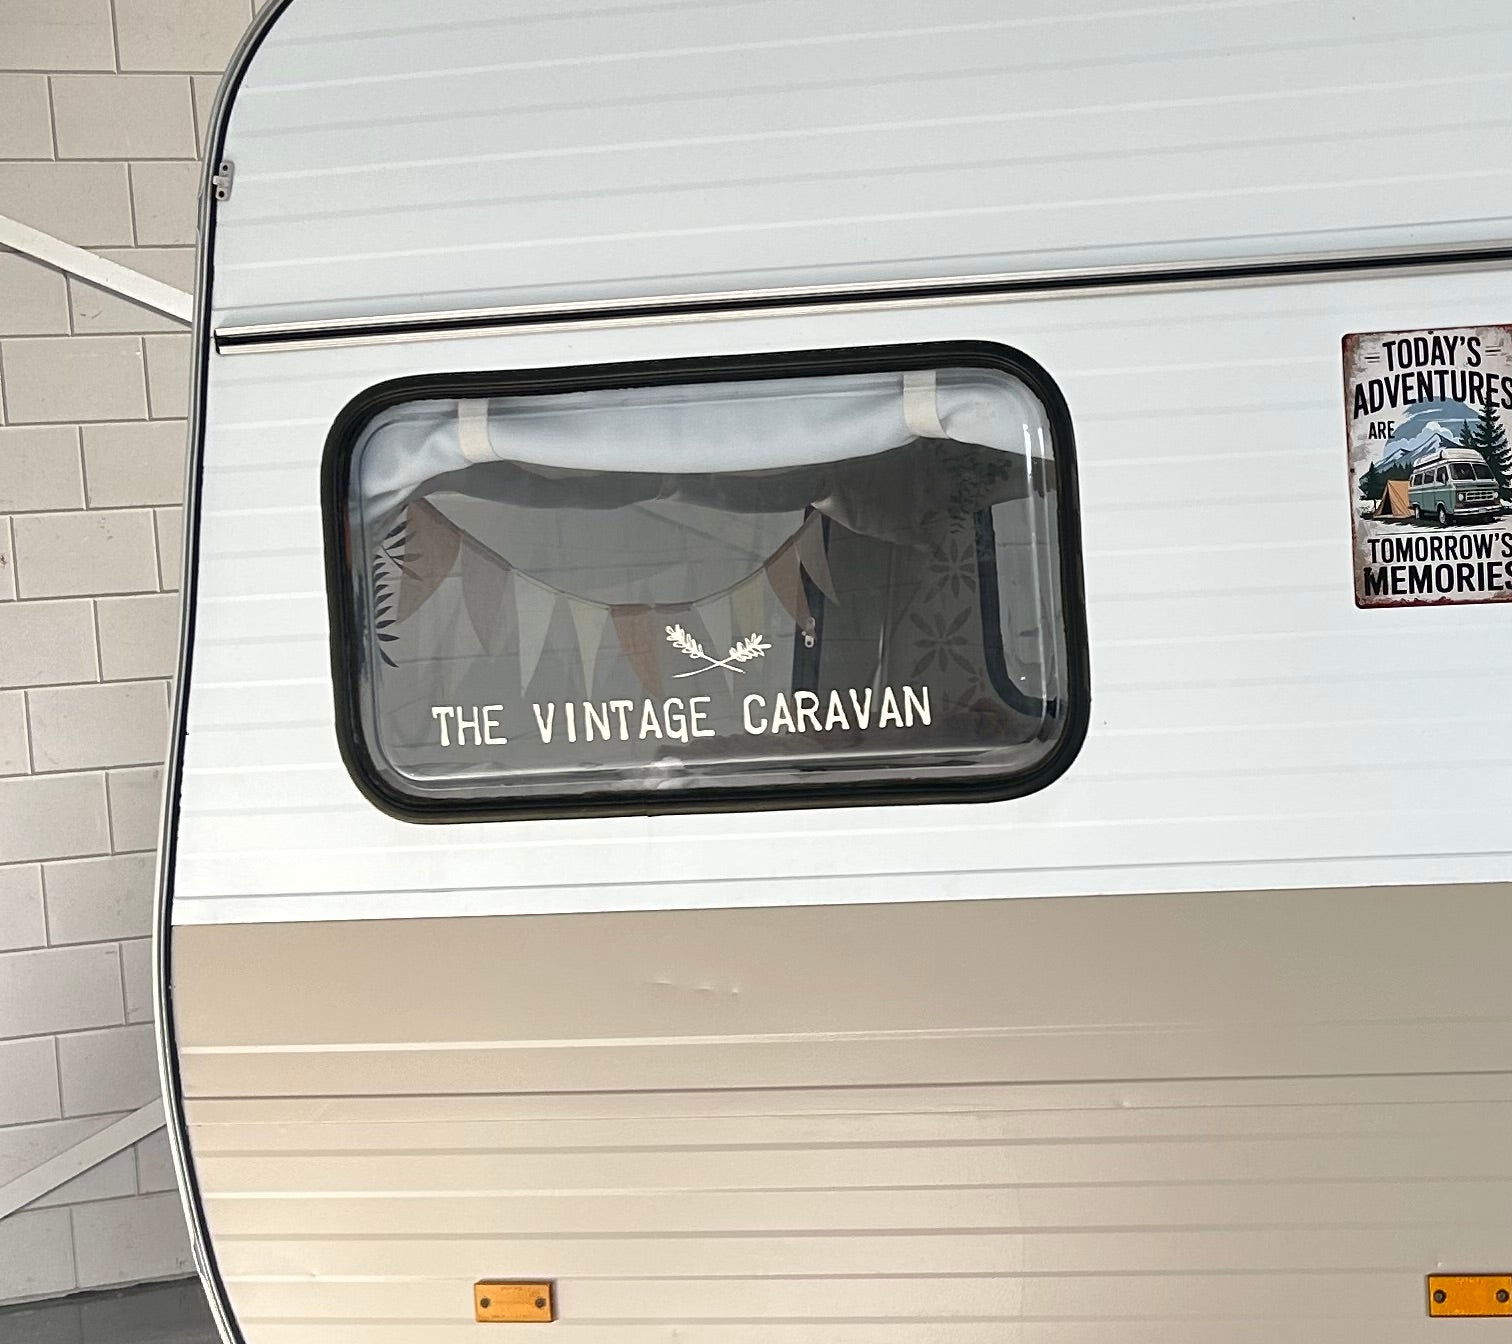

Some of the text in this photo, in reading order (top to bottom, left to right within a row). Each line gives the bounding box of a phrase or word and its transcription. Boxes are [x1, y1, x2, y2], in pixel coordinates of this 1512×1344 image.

[1382, 335, 1482, 372] TODAY'S
[1368, 420, 1396, 440] ARE
[432, 685, 933, 747] THE VINTAGE CARAVAN
